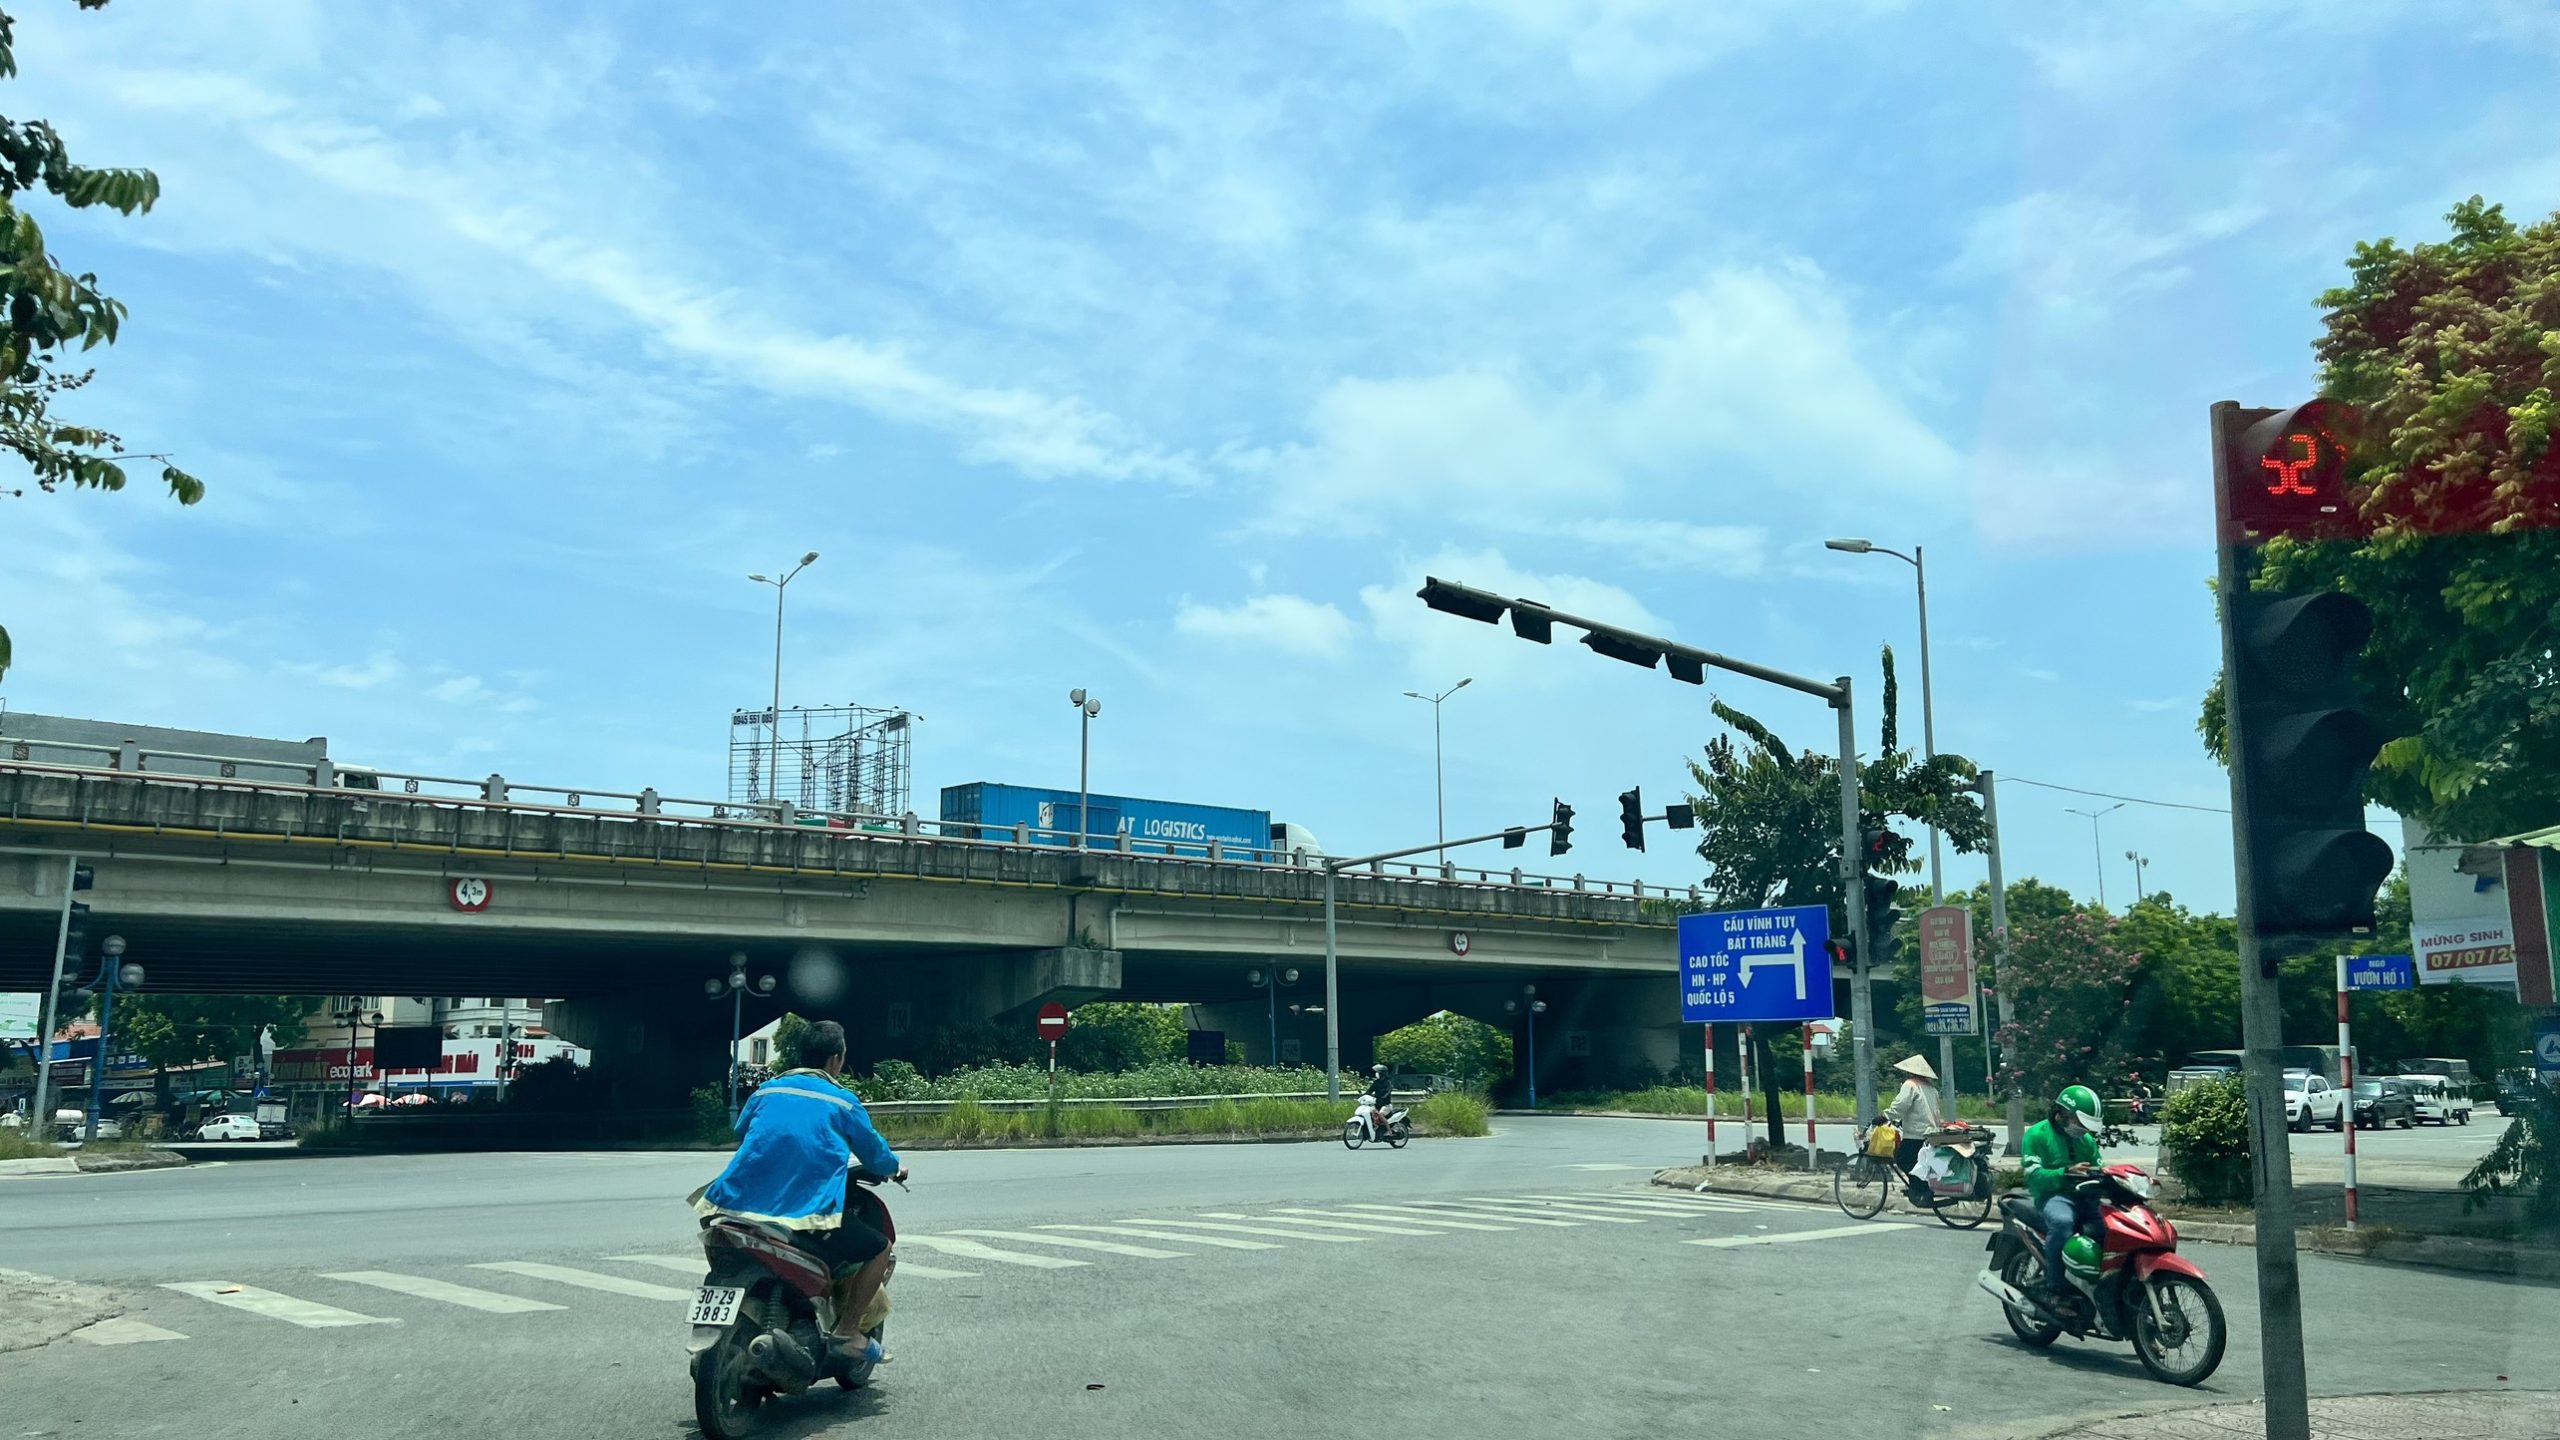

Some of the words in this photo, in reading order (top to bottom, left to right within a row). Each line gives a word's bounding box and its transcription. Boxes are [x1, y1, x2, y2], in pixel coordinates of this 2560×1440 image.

[1144, 818, 1206, 840] LOGISTICS
[1775, 915, 1797, 929] TUY
[1727, 934, 1746, 950] BÁT
[1750, 932, 1787, 949] TRÀNG
[2469, 929, 2504, 942] SINH
[1689, 955, 1708, 969] CAO
[1710, 950, 1730, 968] TỐC
[1692, 974, 1706, 987] HN
[1713, 972, 1727, 986] HP
[2400, 971, 2405, 985] 1
[1687, 988, 1712, 1007] QUỐC
[1728, 991, 1735, 1004] 5
[692, 1306, 730, 1321] 3883
